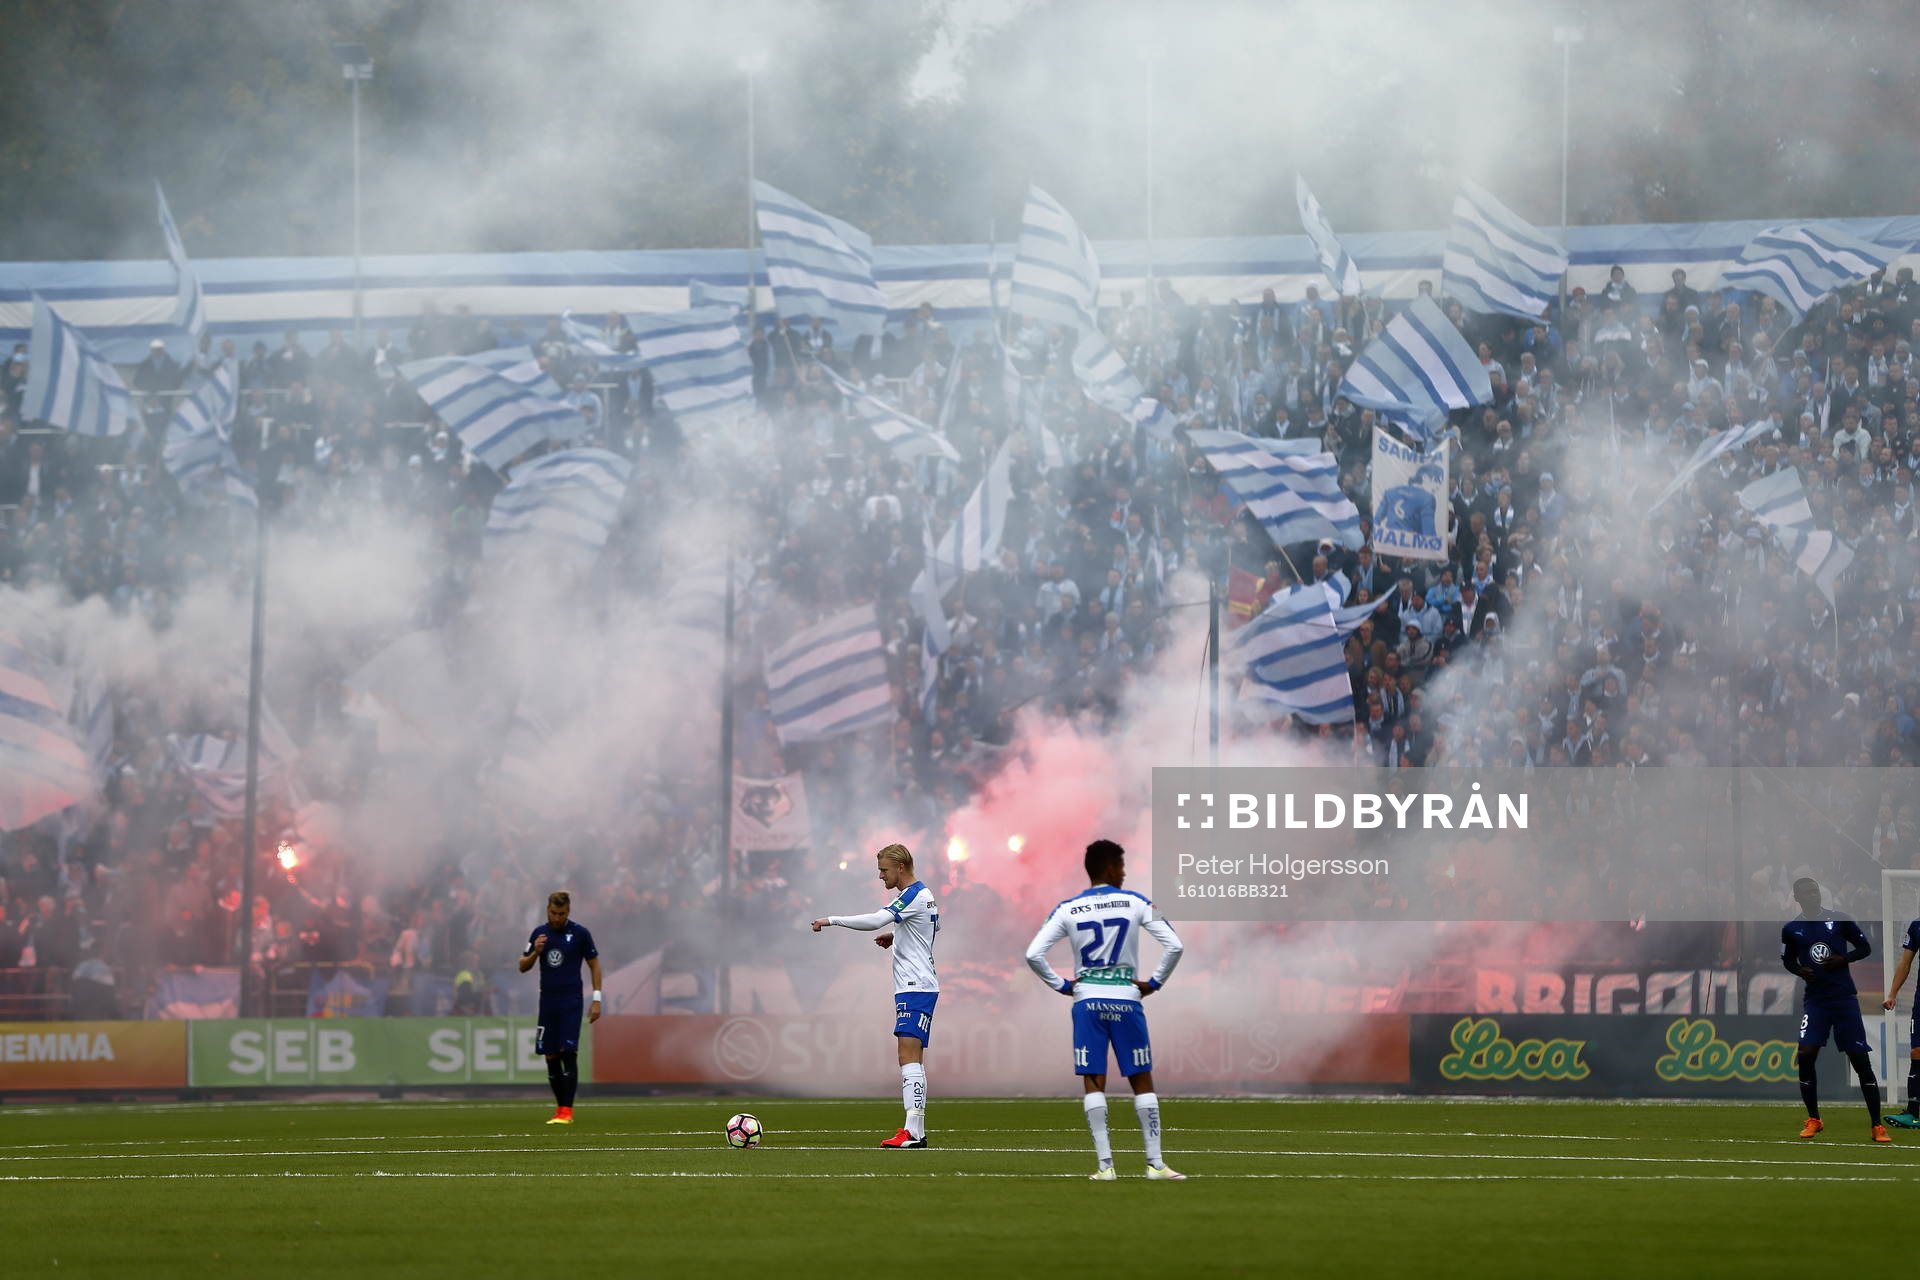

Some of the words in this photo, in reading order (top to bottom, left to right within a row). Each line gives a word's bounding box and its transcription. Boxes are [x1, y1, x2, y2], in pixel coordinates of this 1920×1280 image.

[1076, 917, 1130, 968] 27
[0, 1033, 115, 1062] EMMA
[228, 1029, 356, 1074] SEB
[781, 1022, 1024, 1073] SYNAM
[1440, 1016, 1591, 1081] Leca
[1655, 1018, 1800, 1082] Leca
